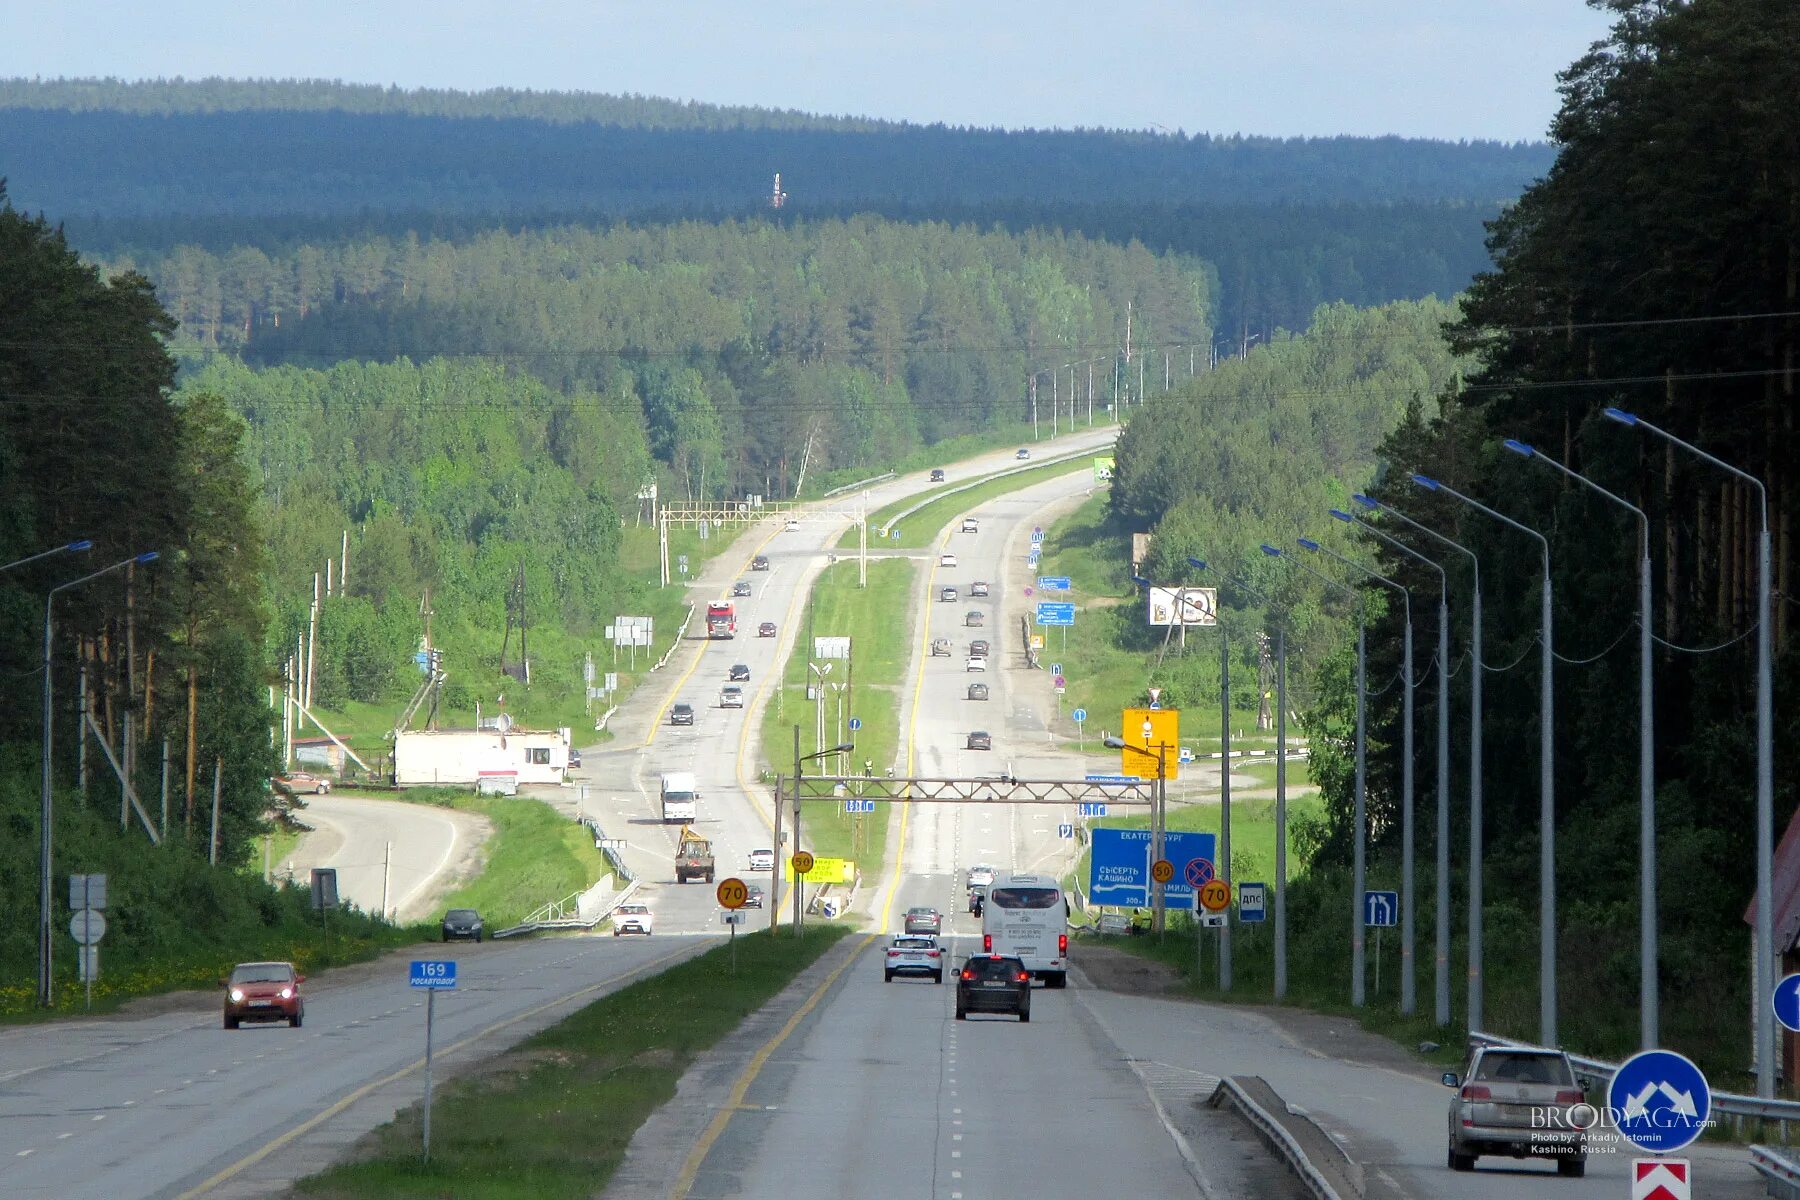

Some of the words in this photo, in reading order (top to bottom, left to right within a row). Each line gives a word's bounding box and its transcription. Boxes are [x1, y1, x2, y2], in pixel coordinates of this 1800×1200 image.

[1121, 832, 1184, 842] ЕКАТЕРБУРГ
[796, 858, 810, 866] 50
[1100, 866, 1139, 875] СЫСЕРТЬ
[1157, 867, 1170, 876] 50
[1098, 874, 1134, 883] КАШИНО
[723, 888, 742, 900] 70
[1207, 890, 1225, 902] 70
[1243, 895, 1261, 905] ДПС
[420, 963, 445, 977] 169
